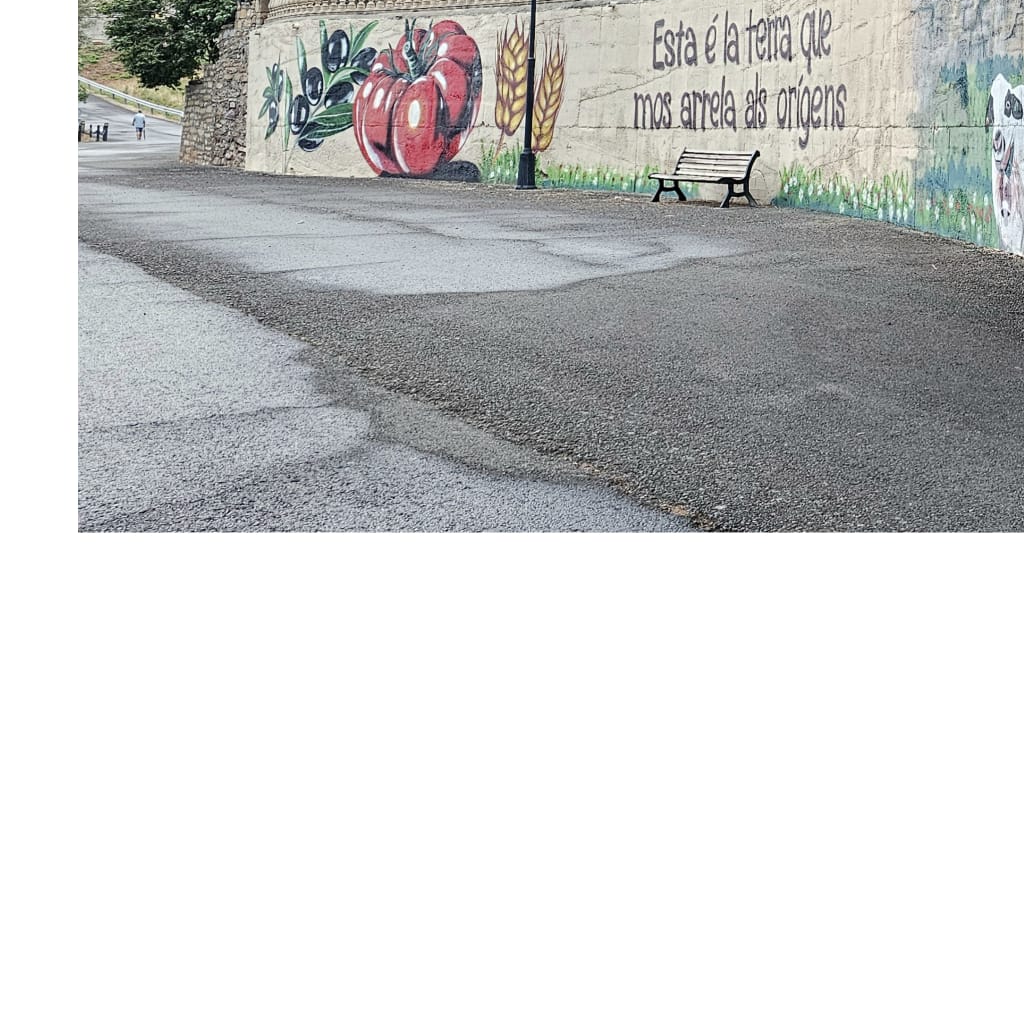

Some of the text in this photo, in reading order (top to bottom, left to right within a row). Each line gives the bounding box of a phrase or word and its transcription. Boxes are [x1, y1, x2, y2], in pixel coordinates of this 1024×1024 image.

[652, 8, 832, 74] Esta é la terra que
[633, 72, 848, 150] mos arrela als orígens
